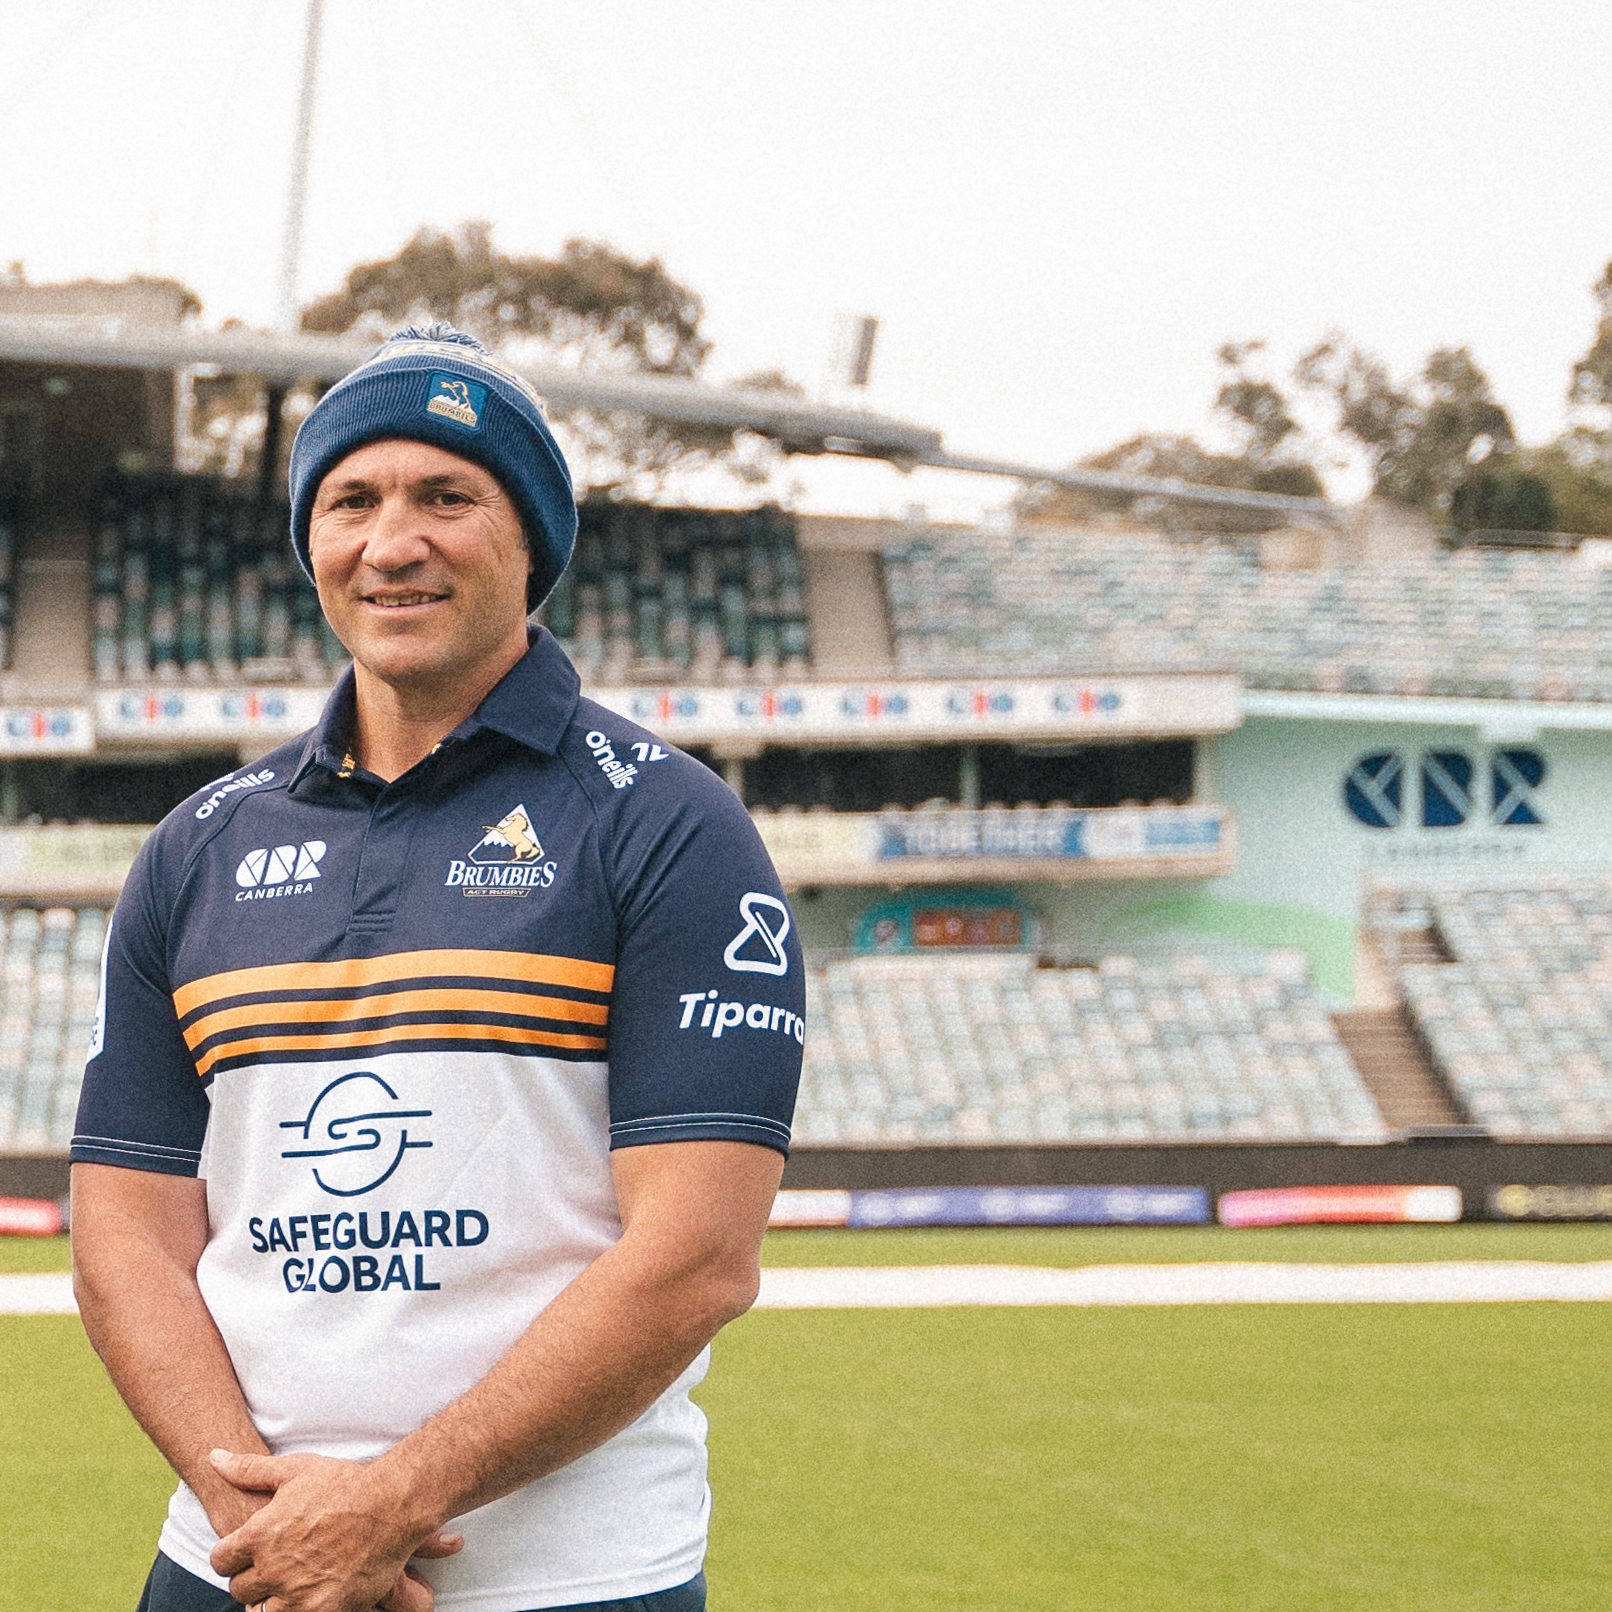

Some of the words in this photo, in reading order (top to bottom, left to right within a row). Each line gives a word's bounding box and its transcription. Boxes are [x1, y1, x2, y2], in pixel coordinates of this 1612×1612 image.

[444, 860, 558, 888] BRUMBIES
[235, 882, 313, 902] CANBERRA
[249, 1209, 489, 1254] SAFEGUARD
[283, 1254, 441, 1294] GLOBAL
